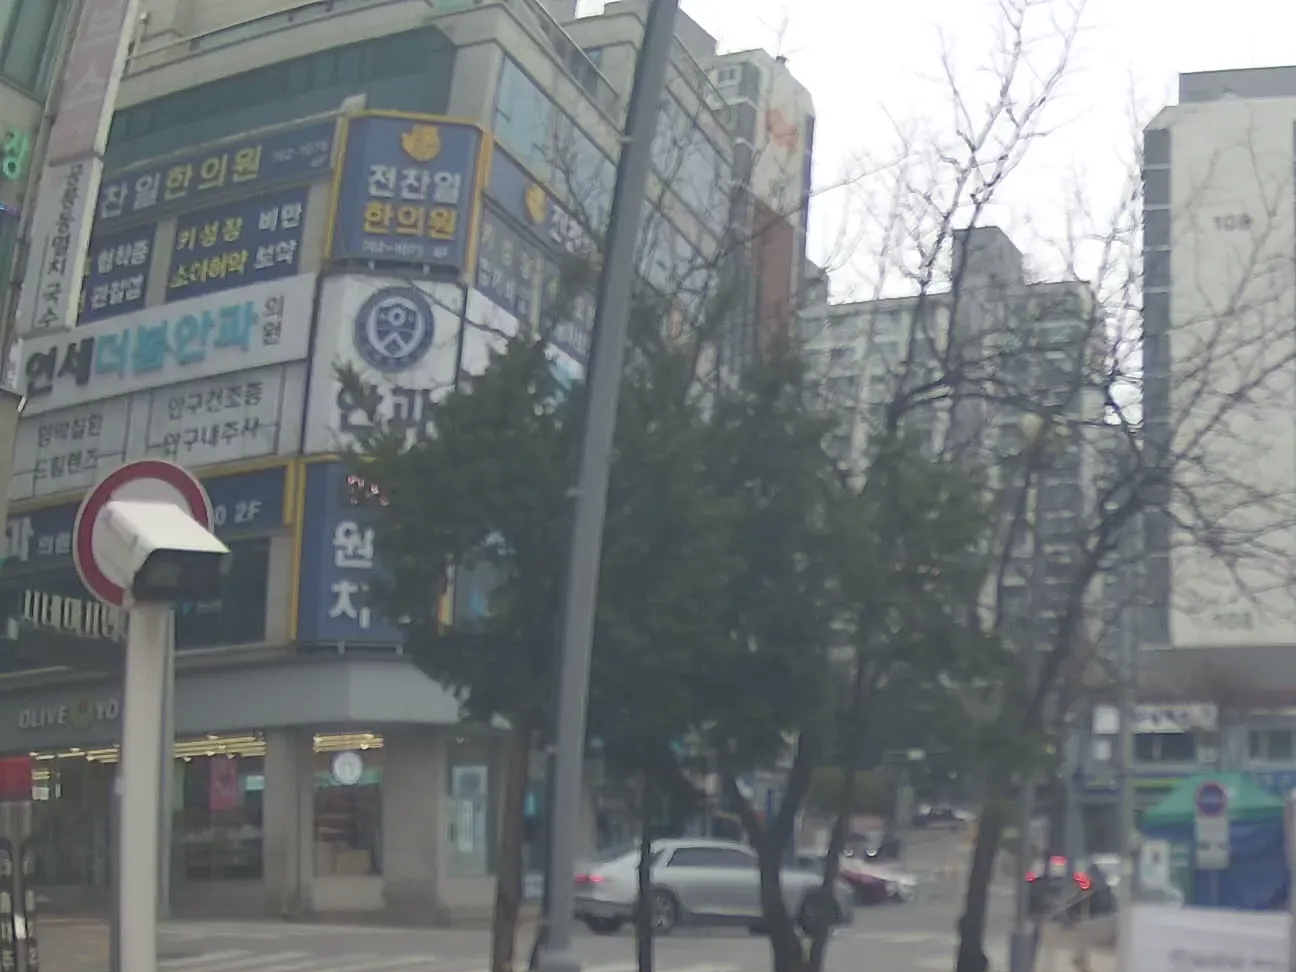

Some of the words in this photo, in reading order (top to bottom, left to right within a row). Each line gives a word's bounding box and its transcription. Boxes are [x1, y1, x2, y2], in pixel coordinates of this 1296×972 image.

[368, 164, 461, 204] 전찬일
[258, 203, 302, 231] 비만
[363, 201, 457, 240] 한의원
[19, 704, 68, 729] OLIVE
